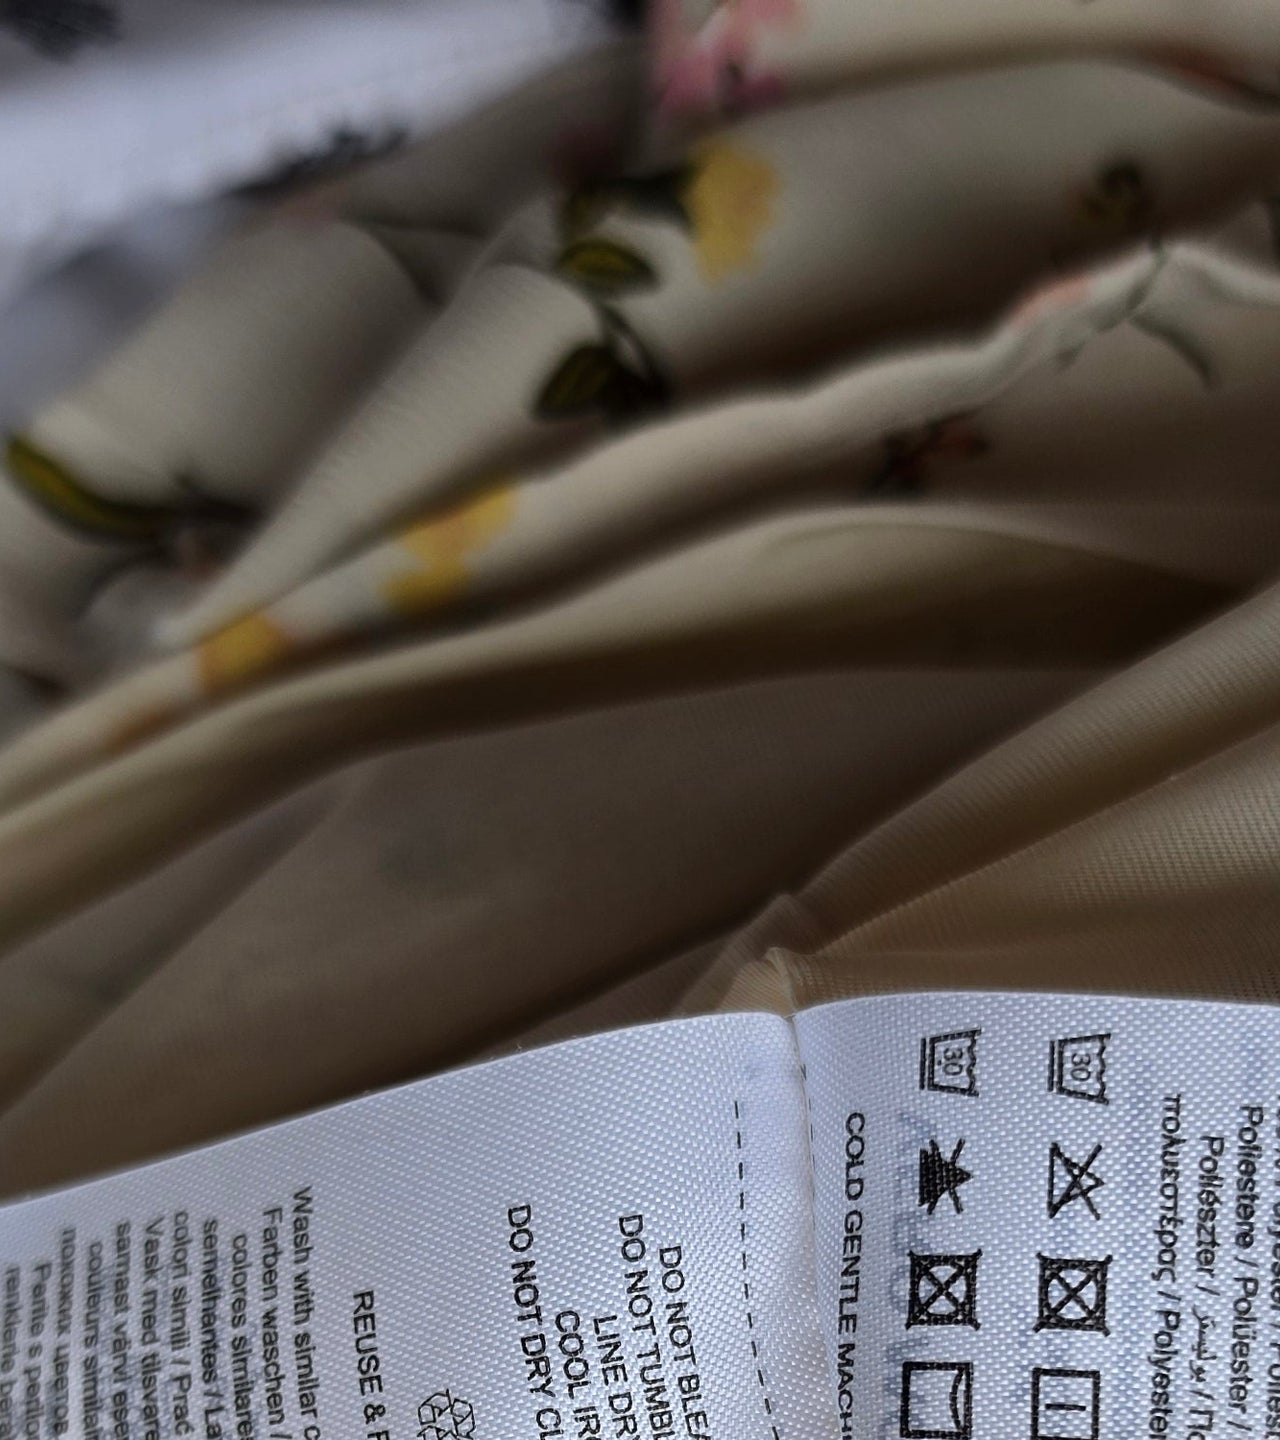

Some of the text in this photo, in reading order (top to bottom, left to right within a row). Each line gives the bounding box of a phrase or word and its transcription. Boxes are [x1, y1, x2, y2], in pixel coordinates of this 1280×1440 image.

[1068, 1052, 1092, 1082] 30
[844, 1111, 867, 1202] COLD
[1235, 1105, 1262, 1250] Poliestere
[263, 1207, 283, 1301] Farben
[294, 1185, 315, 1264] Wash
[506, 1204, 533, 1253] DO
[617, 1213, 646, 1263] DO
[294, 1270, 314, 1325] with
[510, 1260, 541, 1327] NOT
[624, 1270, 656, 1337] NOT
[657, 1245, 685, 1294] DO
[838, 1208, 863, 1335] GENTLE
[262, 1306, 288, 1426] waschen
[352, 1290, 382, 1395] REUSE
[521, 1334, 555, 1400] DRY
[554, 1308, 591, 1399] COOL
[593, 1314, 626, 1386] LINE
[664, 1301, 696, 1367] NOT
[294, 1331, 320, 1418] similar
[362, 1401, 386, 1424] &
